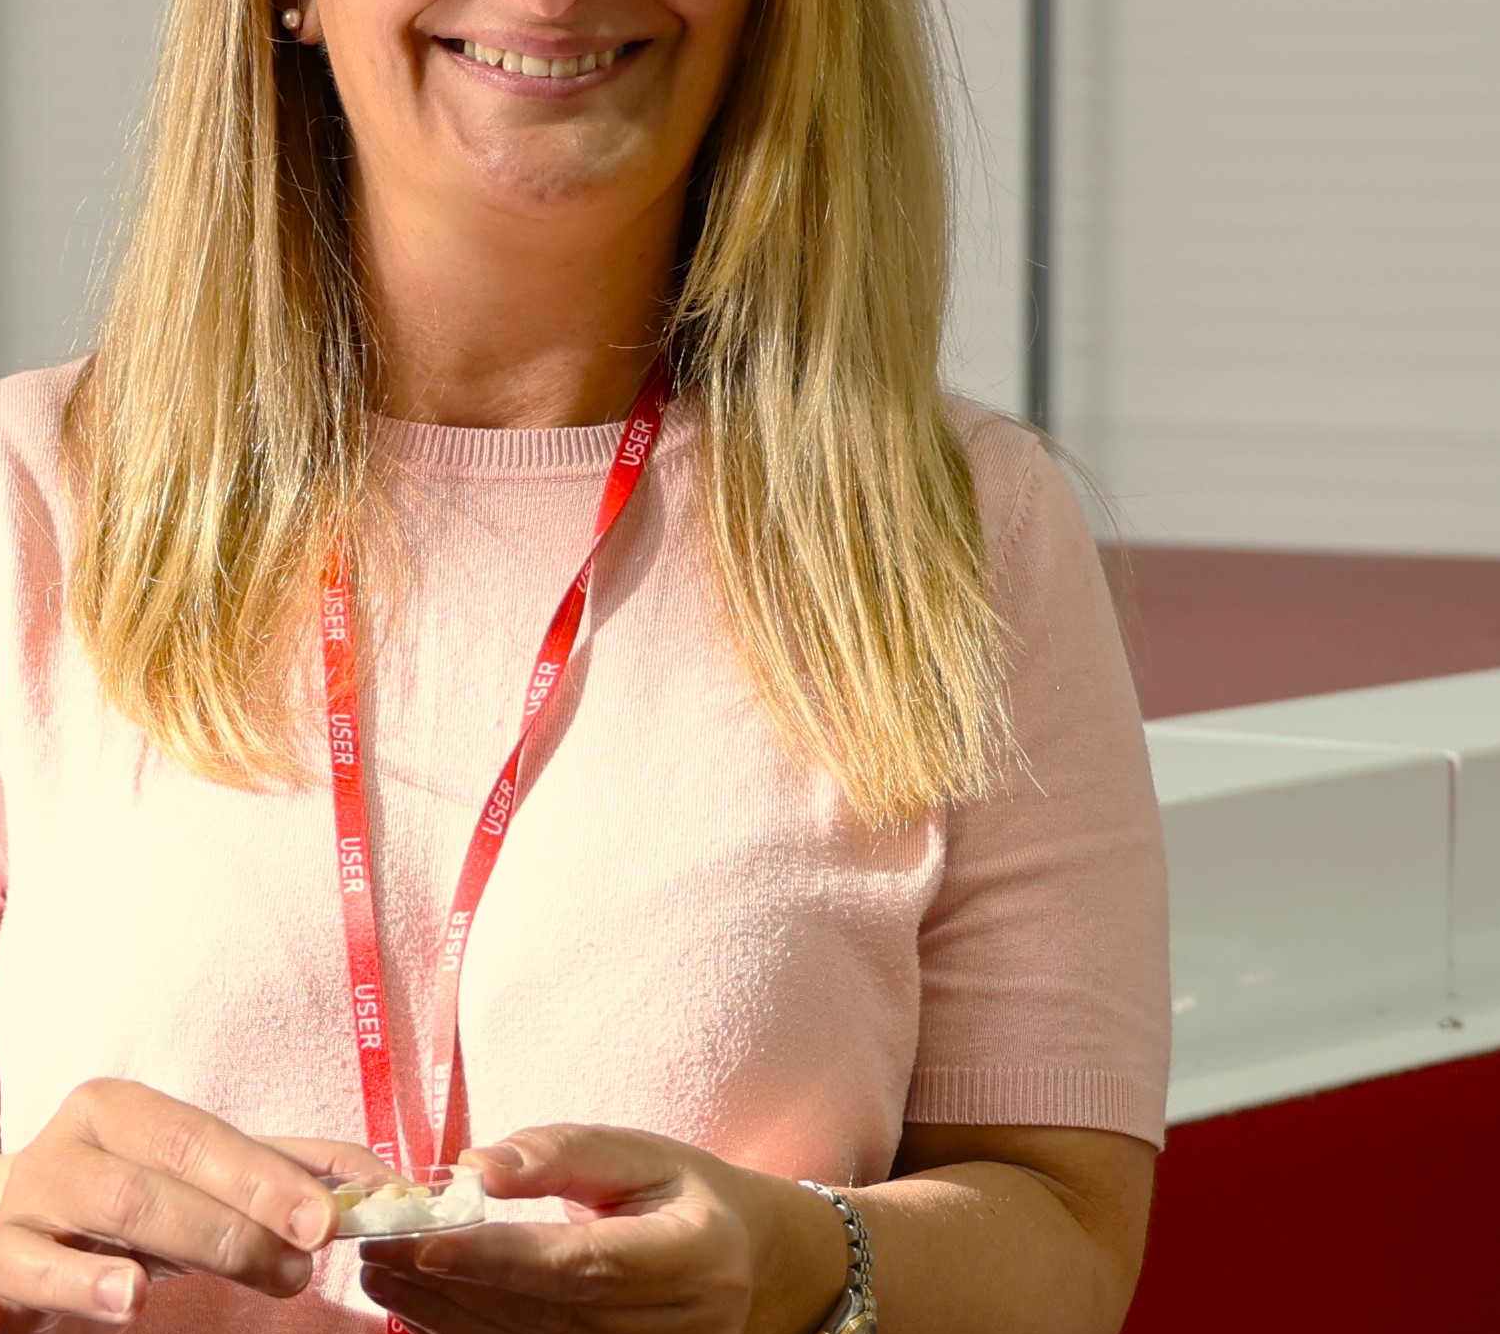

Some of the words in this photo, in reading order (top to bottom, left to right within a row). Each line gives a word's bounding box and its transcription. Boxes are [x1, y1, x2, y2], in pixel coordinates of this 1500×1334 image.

[619, 419, 654, 466] USER
[323, 586, 345, 640] USER
[525, 662, 561, 715] USER
[331, 714, 354, 765] USER
[481, 779, 514, 835] USER
[340, 837, 364, 894] USER
[441, 911, 471, 972] USER
[355, 984, 382, 1050] USER
[433, 1062, 450, 1129] USER
